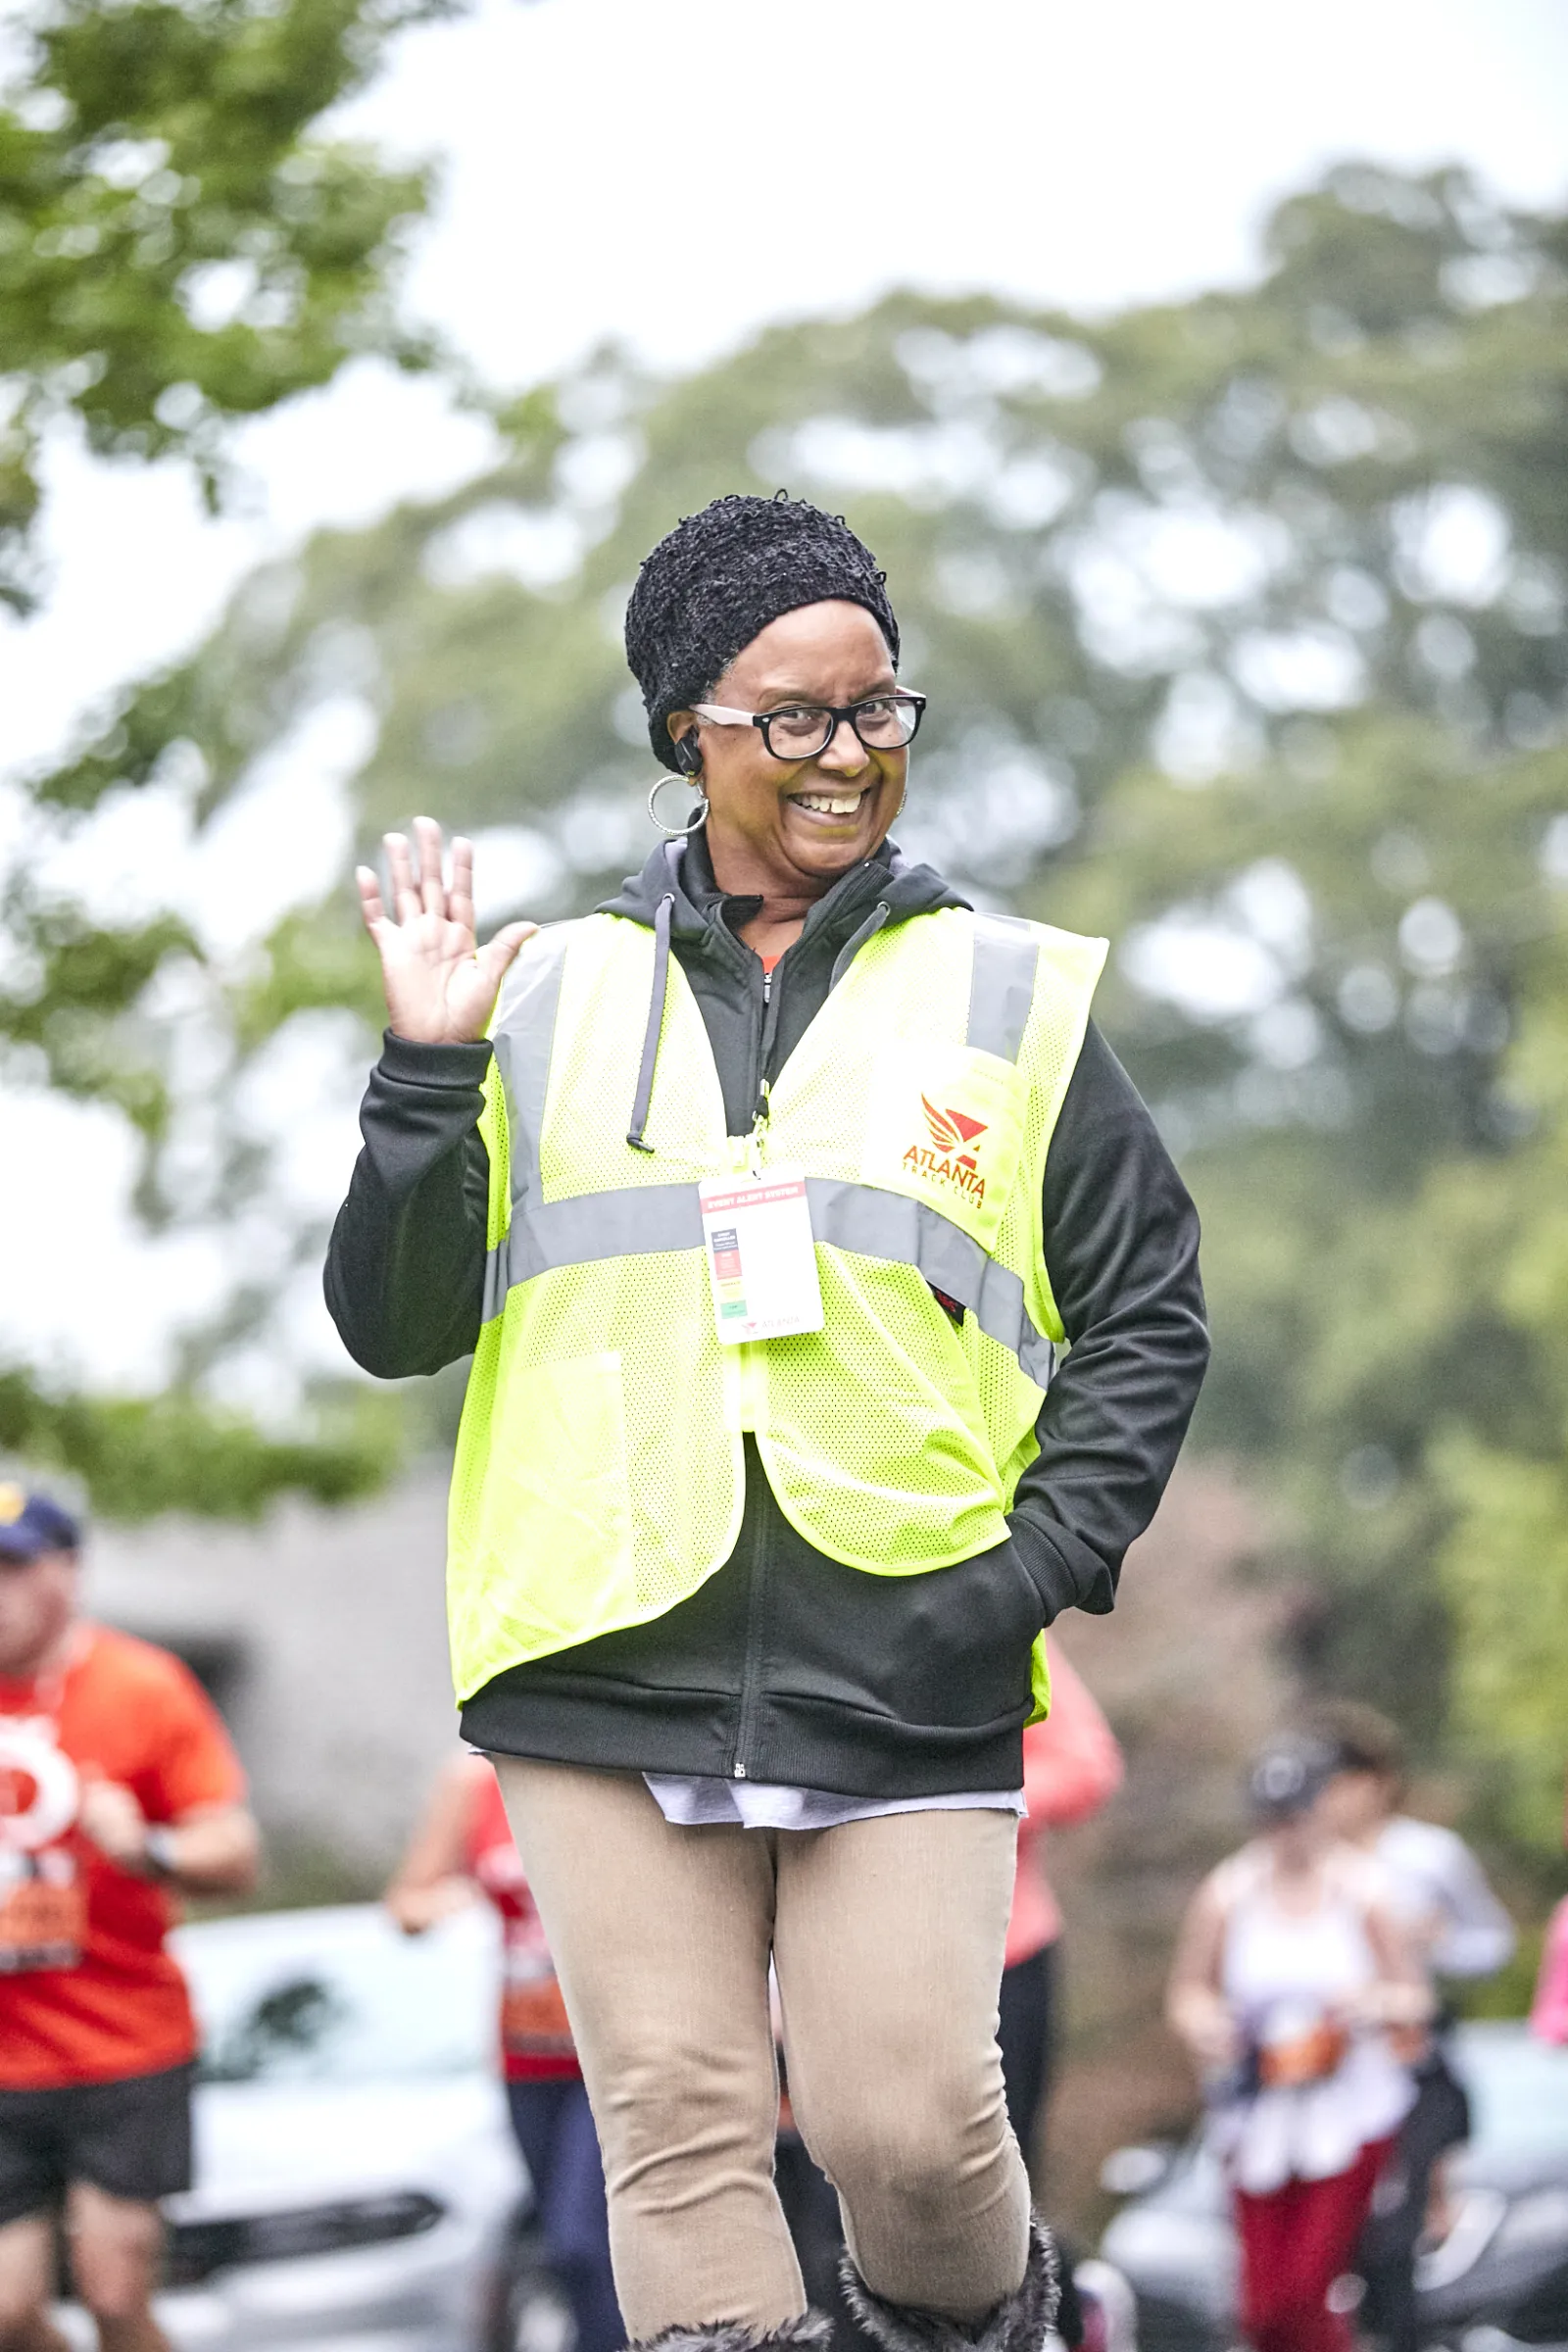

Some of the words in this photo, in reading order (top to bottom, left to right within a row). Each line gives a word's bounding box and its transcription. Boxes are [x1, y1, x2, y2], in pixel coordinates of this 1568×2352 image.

[903, 1145, 986, 1200] ATLANTA
[903, 1162, 946, 1188] TRACK
[954, 1186, 982, 1209] CLUB
